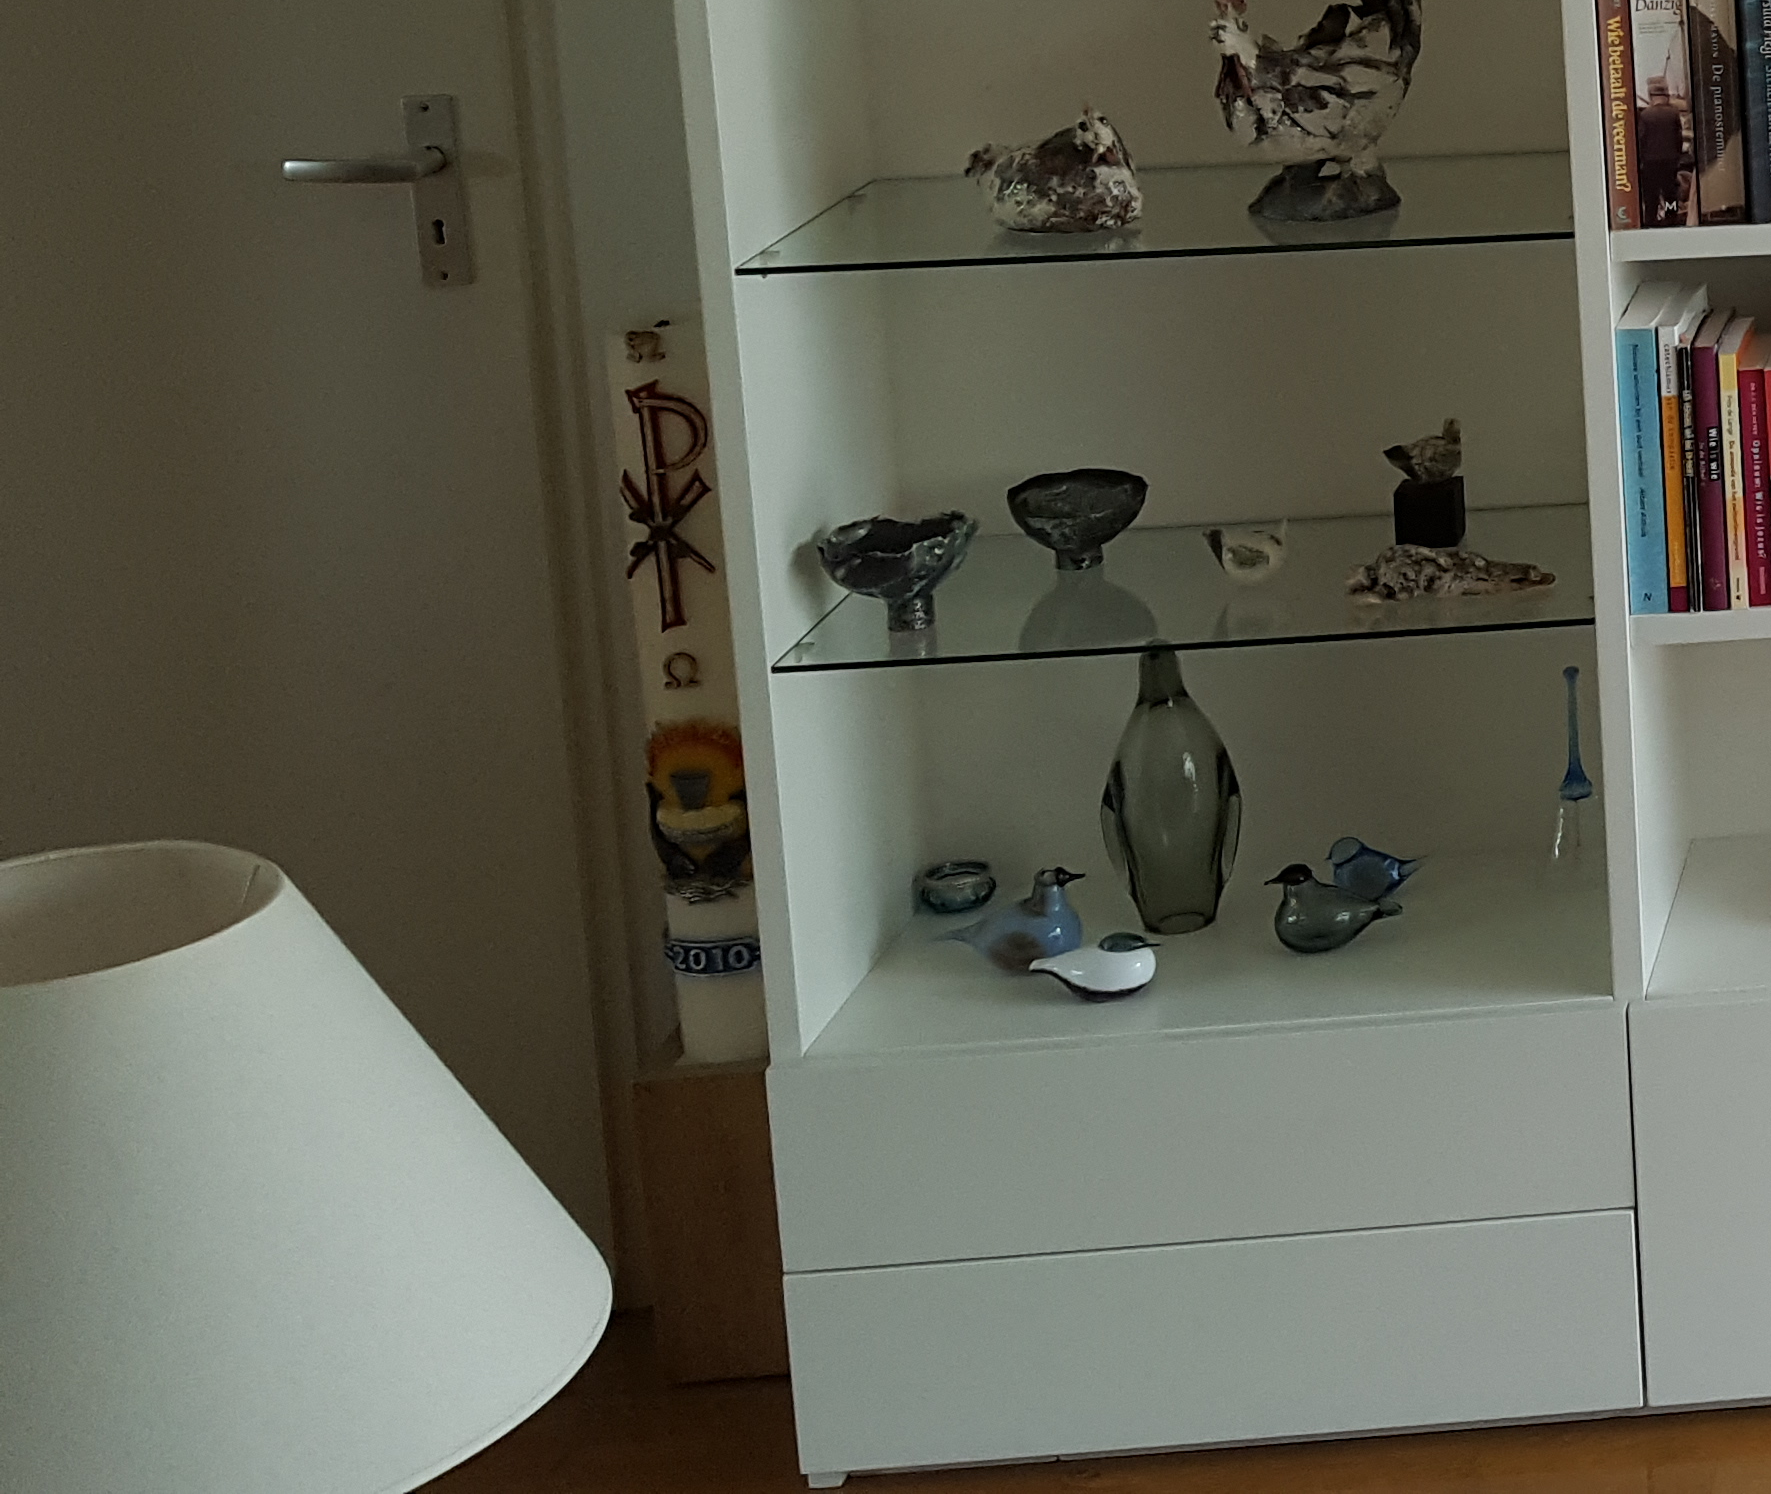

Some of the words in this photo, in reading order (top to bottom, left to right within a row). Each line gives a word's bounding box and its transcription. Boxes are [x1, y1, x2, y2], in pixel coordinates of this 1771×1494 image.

[1607, 16, 1622, 44] Wie
[1609, 46, 1626, 97] betaalt
[1612, 100, 1627, 118] de
[1614, 120, 1631, 192] veerman?
[674, 946, 752, 973] 2010
